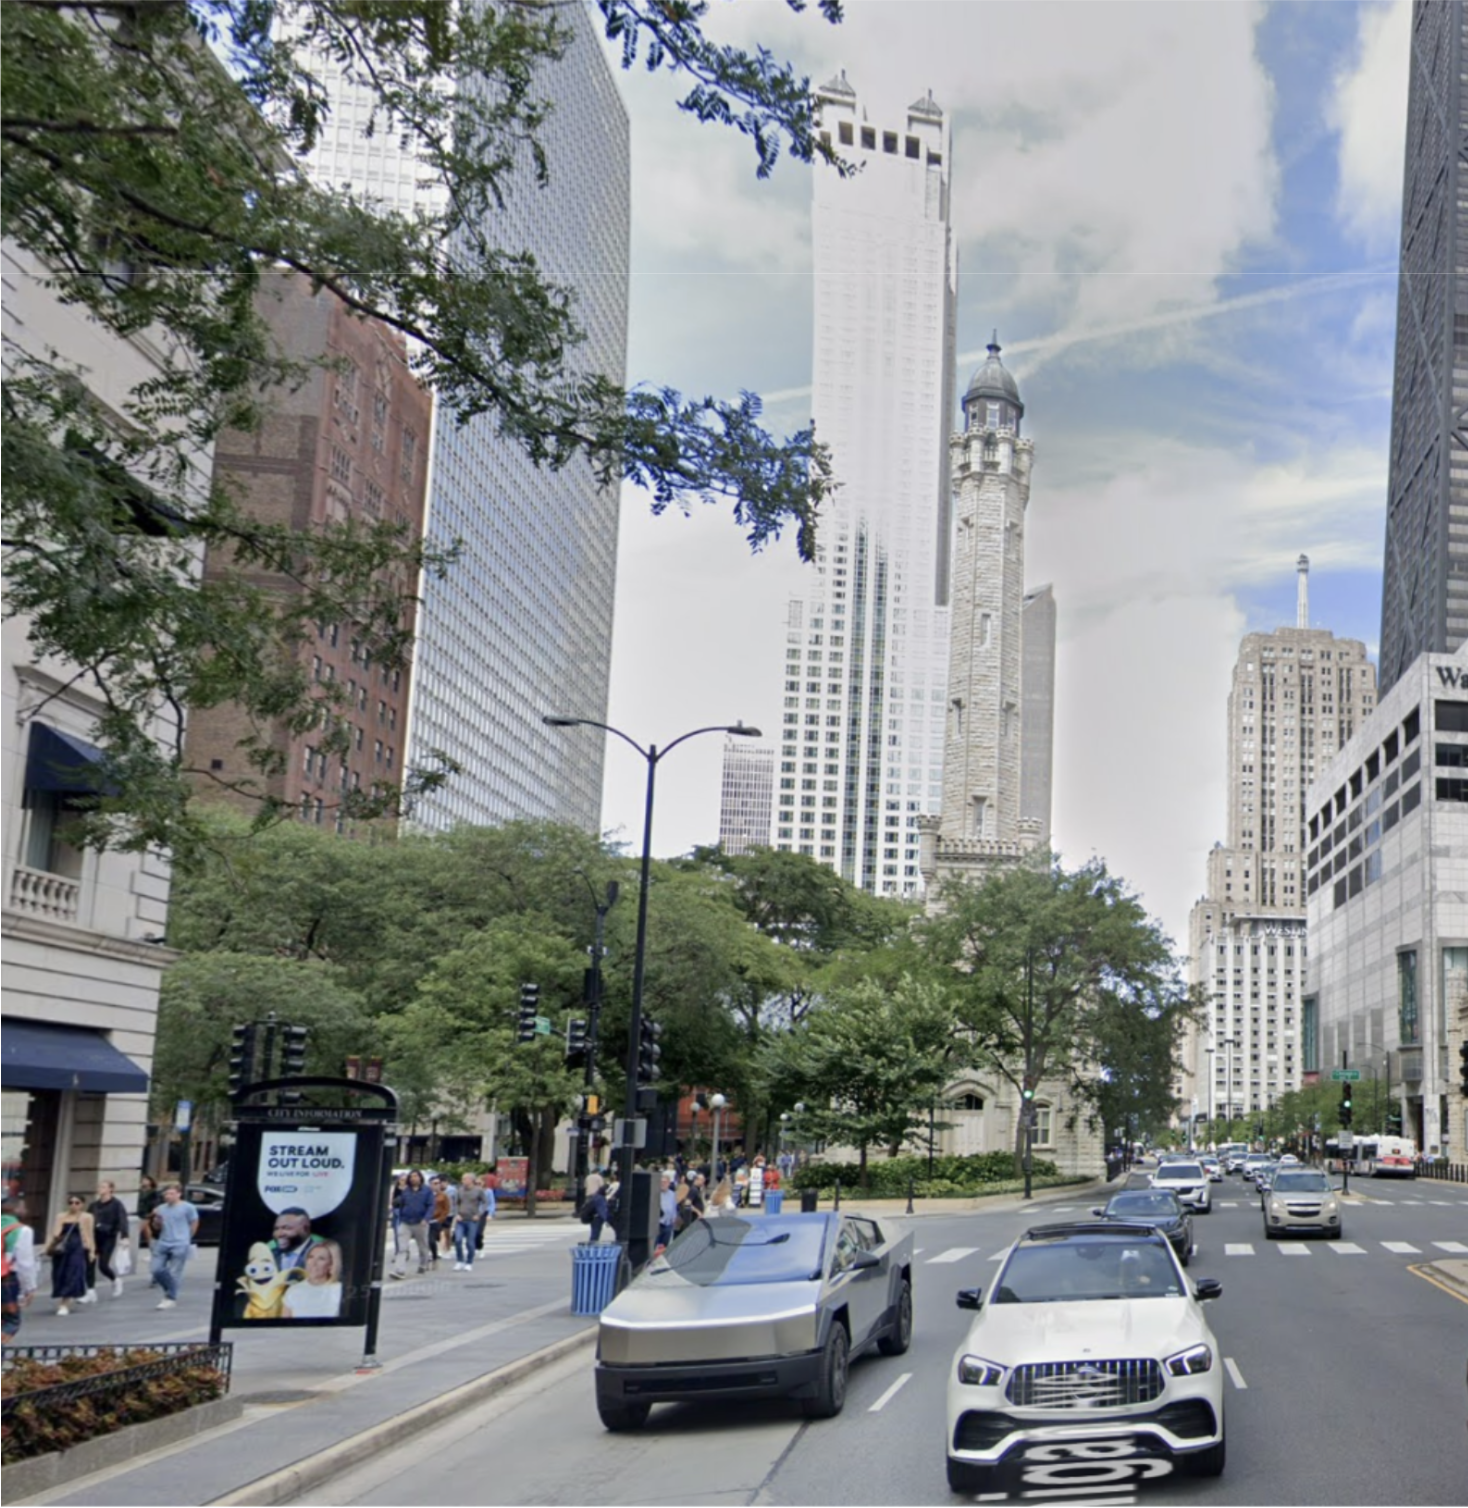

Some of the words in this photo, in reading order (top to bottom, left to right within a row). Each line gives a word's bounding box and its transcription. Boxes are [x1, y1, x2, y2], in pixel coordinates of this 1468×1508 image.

[268, 1109, 291, 1118] CITY
[294, 1109, 363, 1118] INFORMATION
[269, 1145, 329, 1156] STREAM
[268, 1158, 299, 1168] OUT
[302, 1158, 344, 1169] LOUD.
